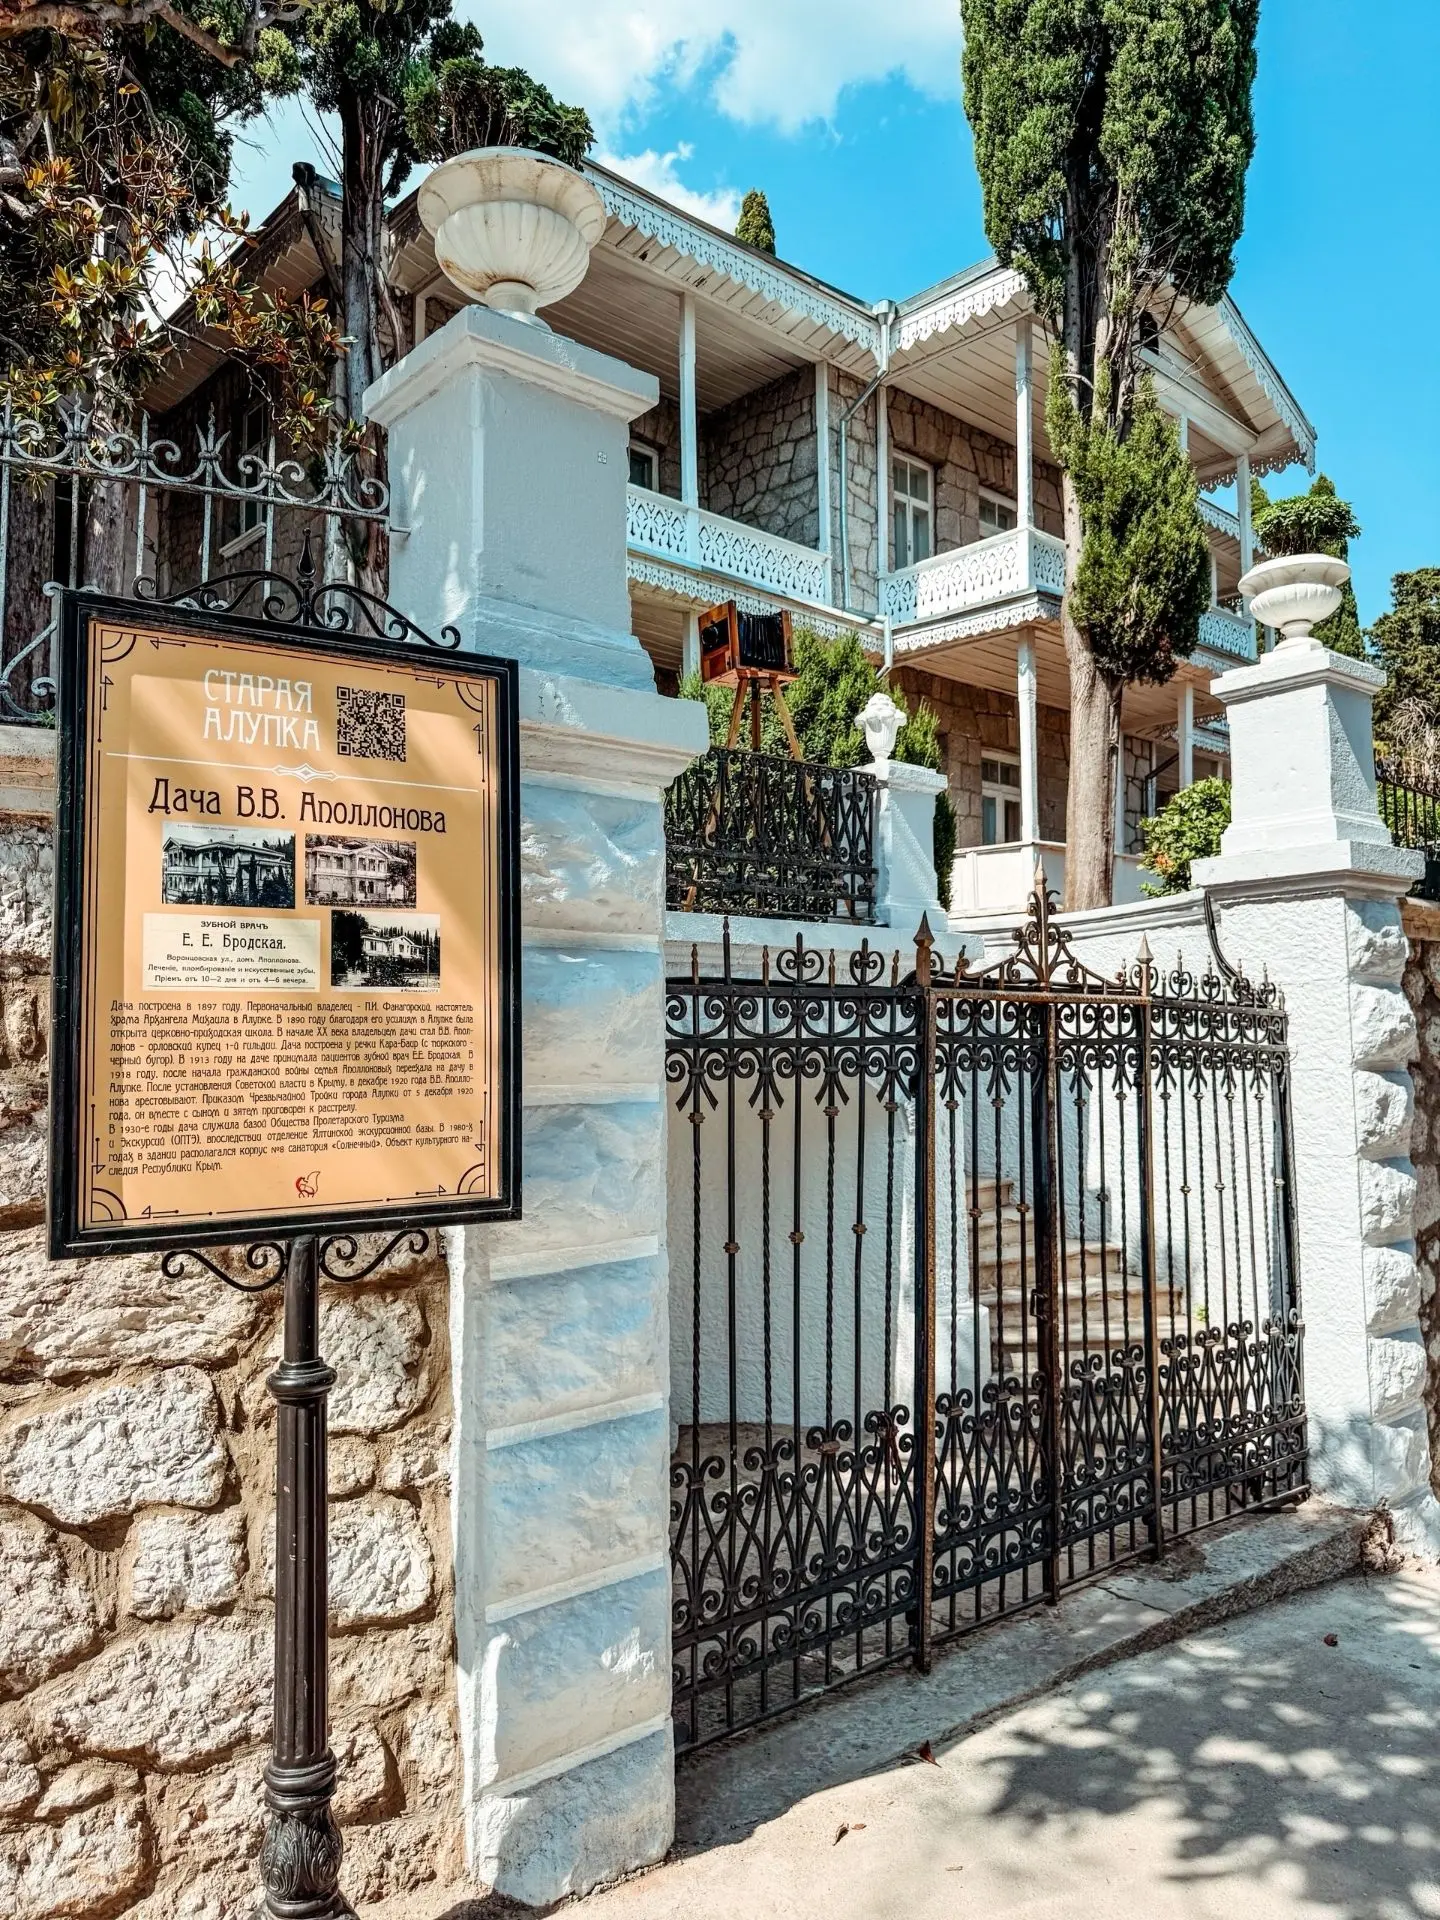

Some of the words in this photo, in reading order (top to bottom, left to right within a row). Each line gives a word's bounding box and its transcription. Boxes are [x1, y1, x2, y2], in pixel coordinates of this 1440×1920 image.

[204, 669, 313, 714] СТАРАЯ
[203, 708, 321, 751] АЛУПКА
[147, 778, 221, 816] Дача
[236, 786, 286, 820] В.В.
[300, 792, 447, 834] Аполлонова
[200, 920, 236, 929] ЗУБНОЙ
[240, 922, 268, 930] ВРАЧЪ
[182, 932, 194, 948] Е.
[202, 934, 213, 948] Е.
[223, 934, 286, 951] Бродская.
[110, 1000, 133, 1012] Дача
[138, 1002, 181, 1013] построена
[247, 1000, 312, 1013] Первоначальный
[316, 1003, 352, 1012] владелец
[110, 1014, 139, 1026] храма
[143, 1013, 187, 1026] Архангела
[191, 1013, 229, 1026] Михаила
[308, 1016, 326, 1026] году
[328, 1013, 367, 1025] благодаря
[384, 1016, 417, 1025] усилиям
[427, 1014, 453, 1025] Алупке
[455, 1014, 473, 1023] была
[110, 1029, 147, 1040] открыта
[150, 1027, 242, 1039] церковно-приходская
[285, 1028, 313, 1037] начале
[330, 1028, 348, 1036] века
[351, 1028, 396, 1038] владельцем
[399, 1028, 417, 1037] дачи
[109, 1043, 135, 1051] лонов
[147, 1041, 192, 1054] орловский
[195, 1042, 221, 1052] купец
[280, 1039, 301, 1050] Дача
[304, 1041, 342, 1051] построена
[354, 1040, 376, 1051] речки
[421, 1038, 428, 1048] (с
[109, 1055, 141, 1068] черный
[189, 1056, 209, 1064] 1913
[213, 1055, 232, 1065] году
[236, 1055, 246, 1063] на
[250, 1054, 269, 1063] даче
[273, 1054, 317, 1064] принимала
[320, 1053, 360, 1062] пациентов
[363, 1050, 389, 1063] зубной
[392, 1052, 409, 1062] врач
[110, 1070, 131, 1079] 1918
[162, 1069, 186, 1077] после
[191, 1068, 221, 1077] начала
[226, 1066, 280, 1079] гражданской
[284, 1065, 309, 1075] войны
[313, 1066, 337, 1075] семья
[342, 1063, 392, 1075] Аполлоновых
[395, 1063, 432, 1074] переехала
[435, 1064, 444, 1072] на
[448, 1063, 465, 1073] дачу
[146, 1081, 172, 1092] После
[175, 1081, 231, 1093] установления
[235, 1078, 276, 1089] Советской
[279, 1079, 306, 1088] власти
[357, 1075, 387, 1087] декабре
[391, 1077, 408, 1085] 1920
[411, 1076, 426, 1085] года
[109, 1097, 129, 1106] нова
[202, 1092, 244, 1106] Приказом
[249, 1090, 305, 1104] Чрезвычайной
[311, 1089, 337, 1102] Тройки
[341, 1090, 367, 1101] города
[371, 1087, 399, 1100] Алупки
[424, 1086, 453, 1098] декабря
[134, 1111, 145, 1119] он
[148, 1109, 179, 1120] вместе
[191, 1108, 219, 1119] сыном
[232, 1107, 258, 1117] зятем
[261, 1105, 305, 1117] приговорен
[119, 1123, 149, 1134] 1930-е
[153, 1123, 174, 1133] годы
[177, 1122, 198, 1132] дача
[202, 1121, 239, 1132] служила
[242, 1117, 266, 1128] базой
[270, 1116, 309, 1128] Общества
[313, 1113, 368, 1127] Пролетарского
[372, 1112, 404, 1124] Туризма
[206, 1133, 261, 1144] впоследствии
[266, 1130, 307, 1141] отделение
[312, 1126, 353, 1138] Ялтинской
[357, 1125, 411, 1139] экскурсионной
[449, 1122, 473, 1133] 1980-х
[108, 1150, 134, 1163] годах
[146, 1150, 176, 1161] здании
[180, 1147, 236, 1160] располагался
[239, 1145, 267, 1157] корпус
[287, 1142, 328, 1154] санатория
[385, 1136, 412, 1147] Объект
[415, 1136, 459, 1147] культурного
[108, 1165, 138, 1176] следия
[141, 1160, 191, 1176] Республики
[195, 1159, 222, 1173] Крым.
